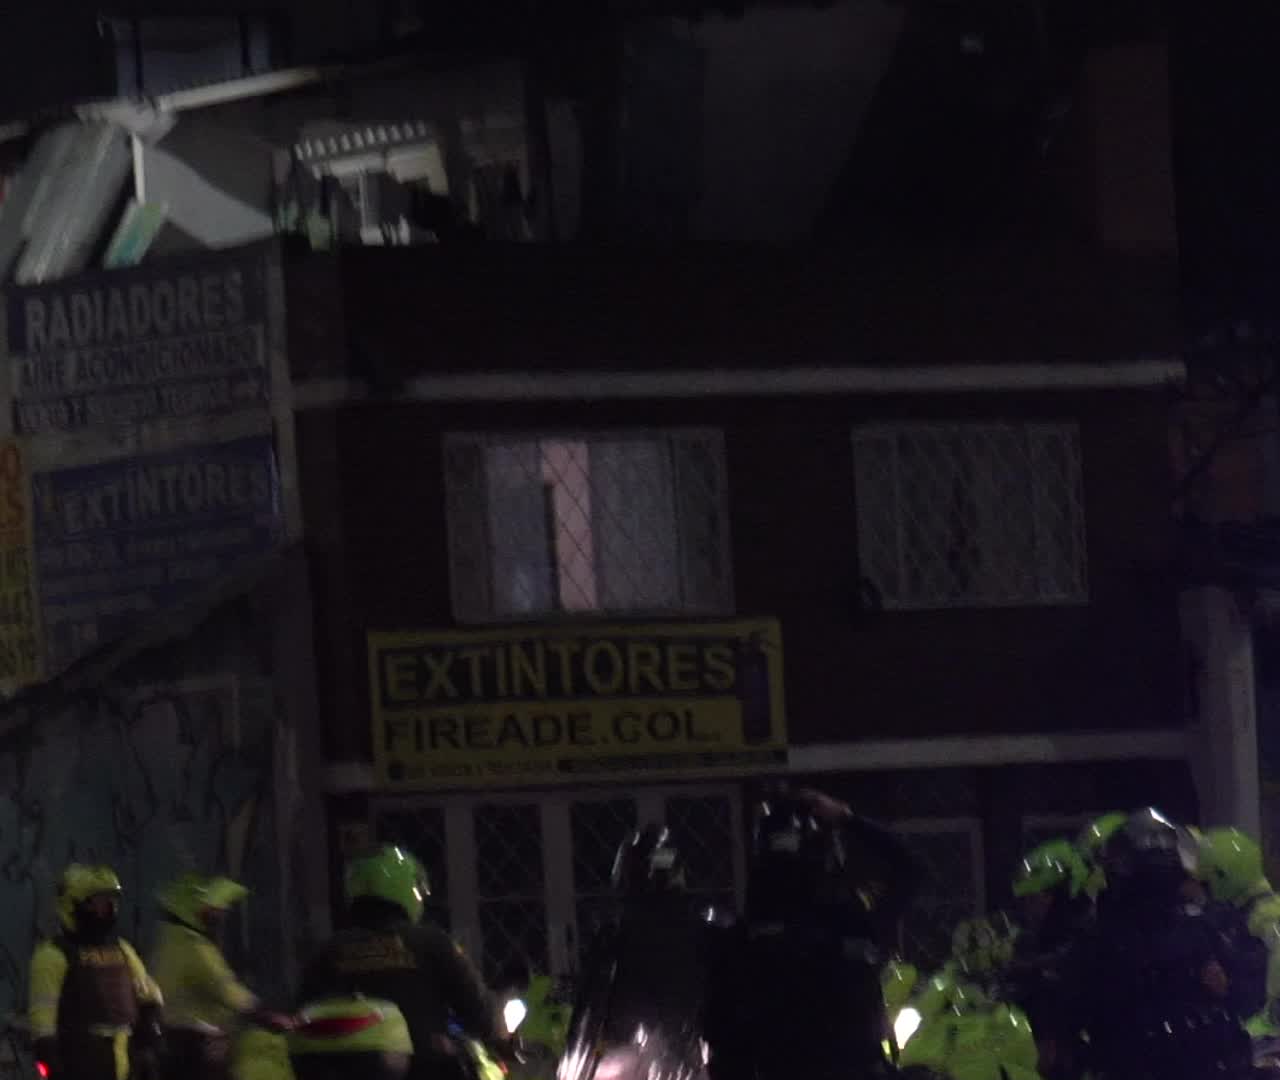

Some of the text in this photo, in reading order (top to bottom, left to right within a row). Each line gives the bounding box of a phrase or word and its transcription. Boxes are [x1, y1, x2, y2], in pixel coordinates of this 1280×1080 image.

[26, 272, 243, 352] RADIADORES
[63, 463, 270, 527] EXTINTORES
[385, 640, 736, 699] EXTINTORES
